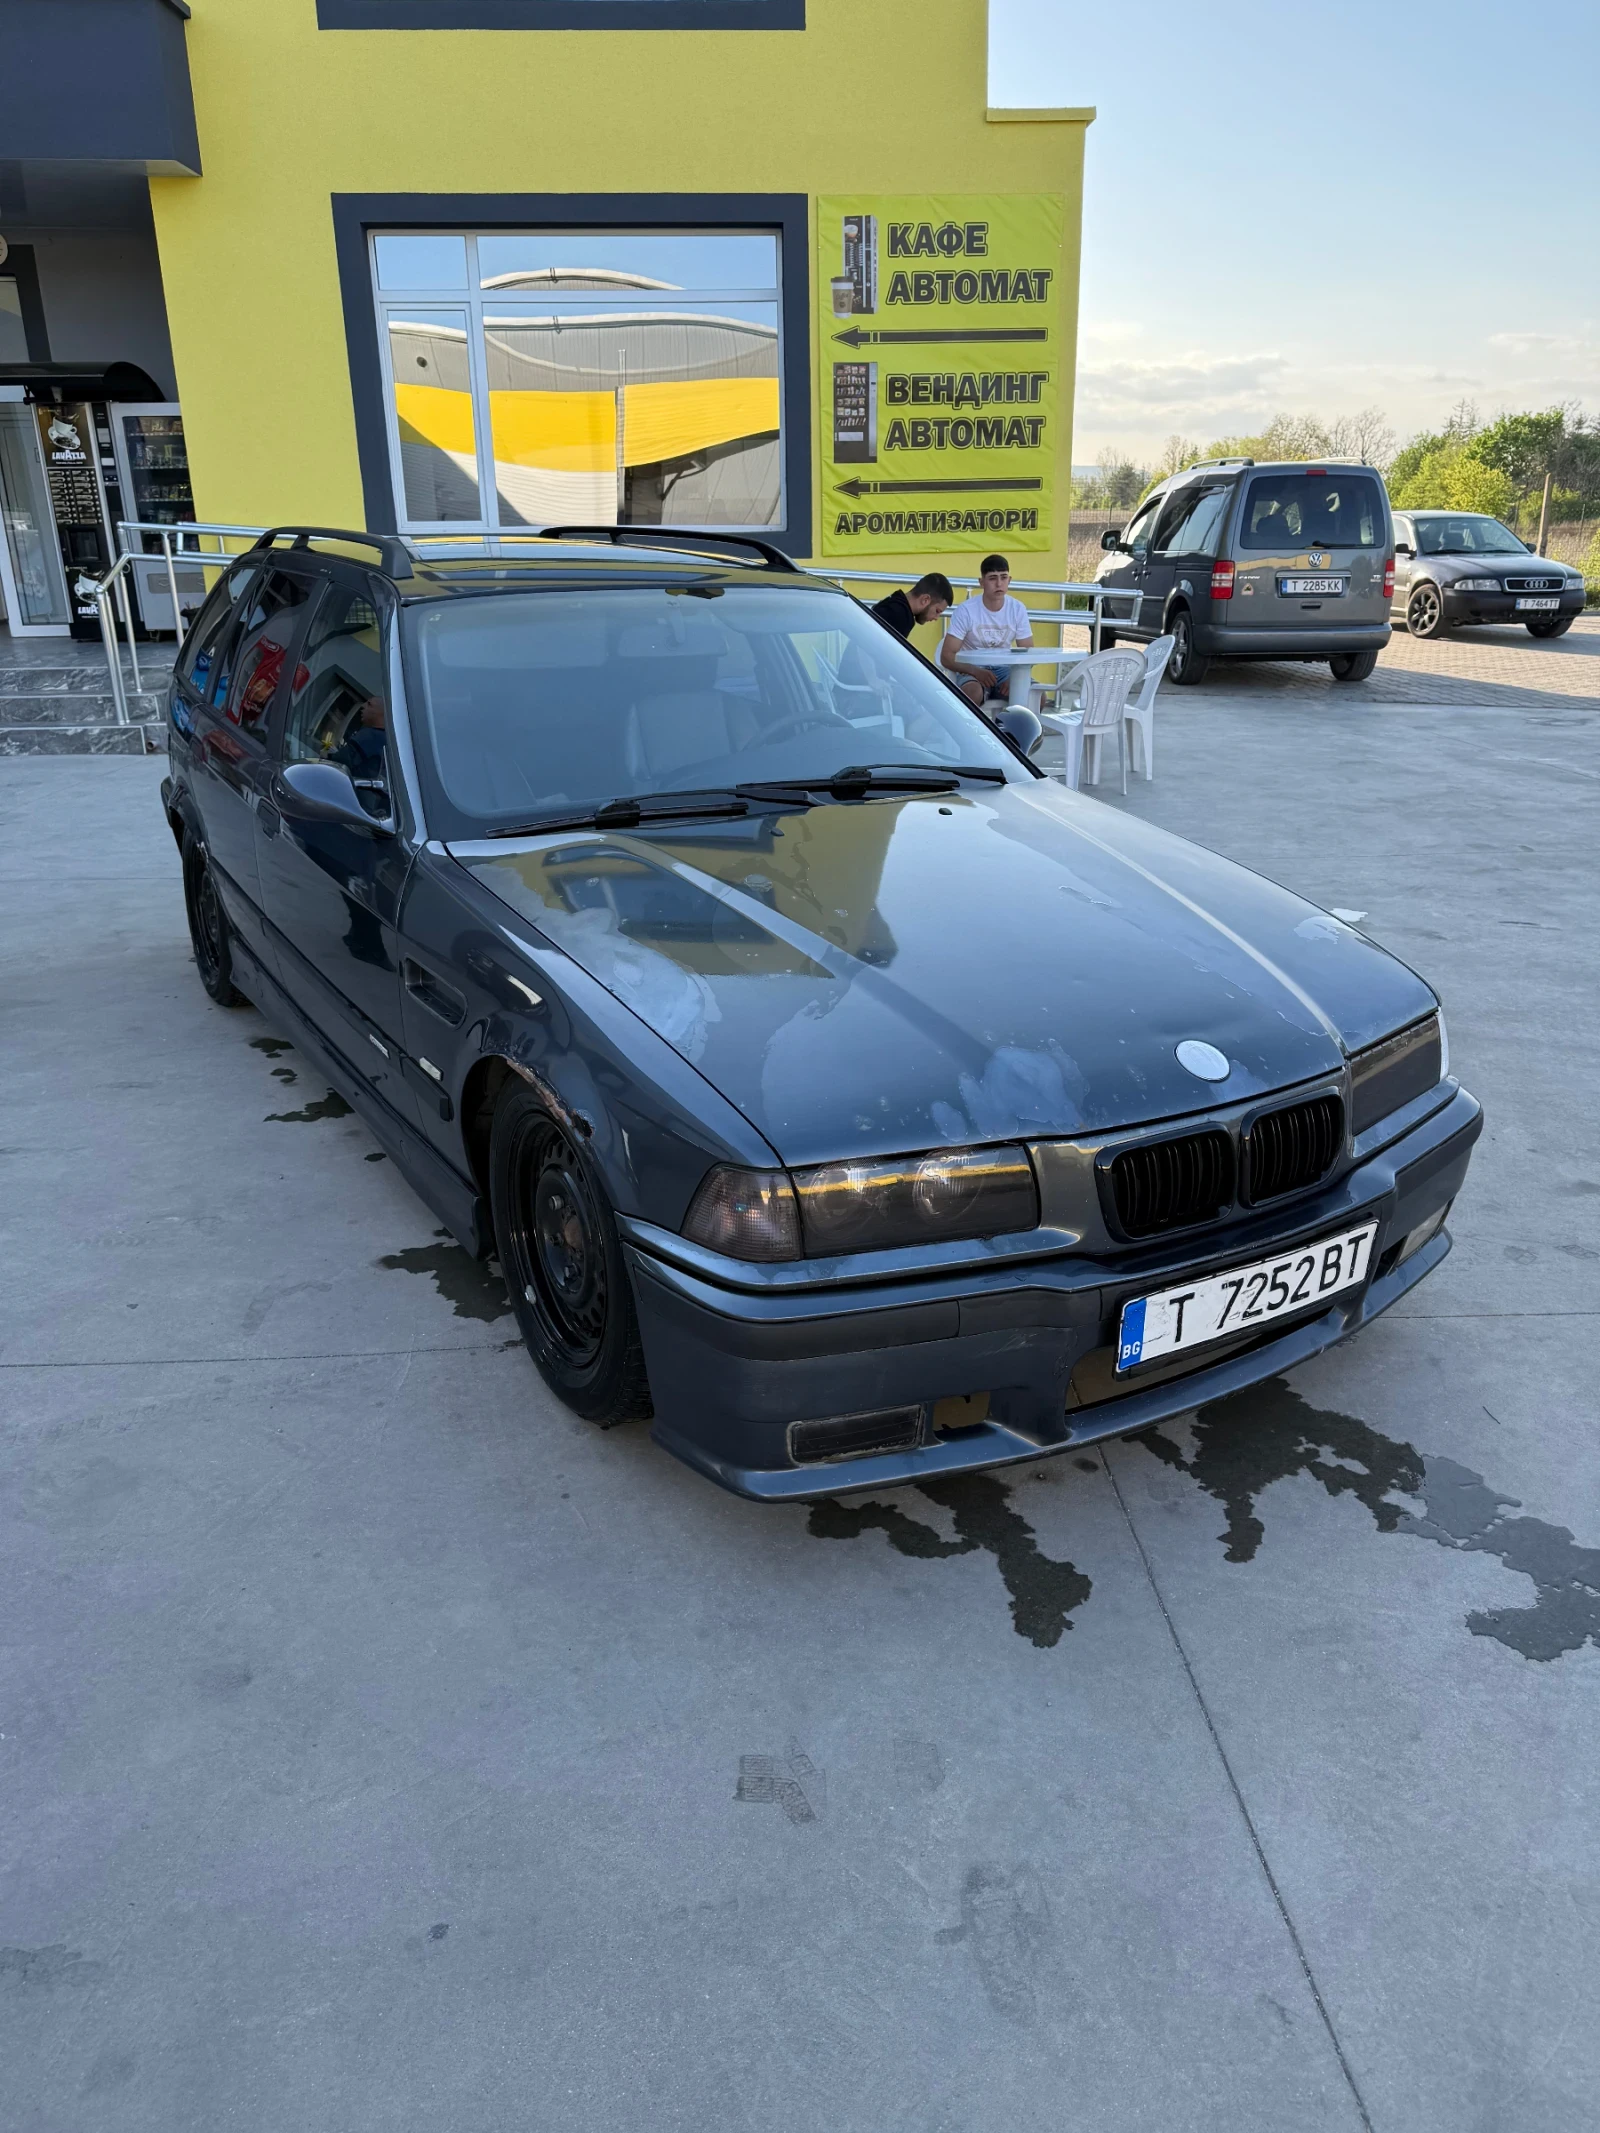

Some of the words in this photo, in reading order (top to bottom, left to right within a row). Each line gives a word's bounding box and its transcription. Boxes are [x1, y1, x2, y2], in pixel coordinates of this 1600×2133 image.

[887, 221, 989, 258] КАФЕ
[886, 269, 1053, 305] АВТОМАТ
[885, 372, 1050, 410] ВЕНДИНГ
[884, 416, 1047, 451] АВТОМАТ
[834, 508, 1039, 535] АРОМАТИЗАТОРИ
[1169, 1292, 1195, 1343] T
[1122, 1341, 1141, 1360] BG
